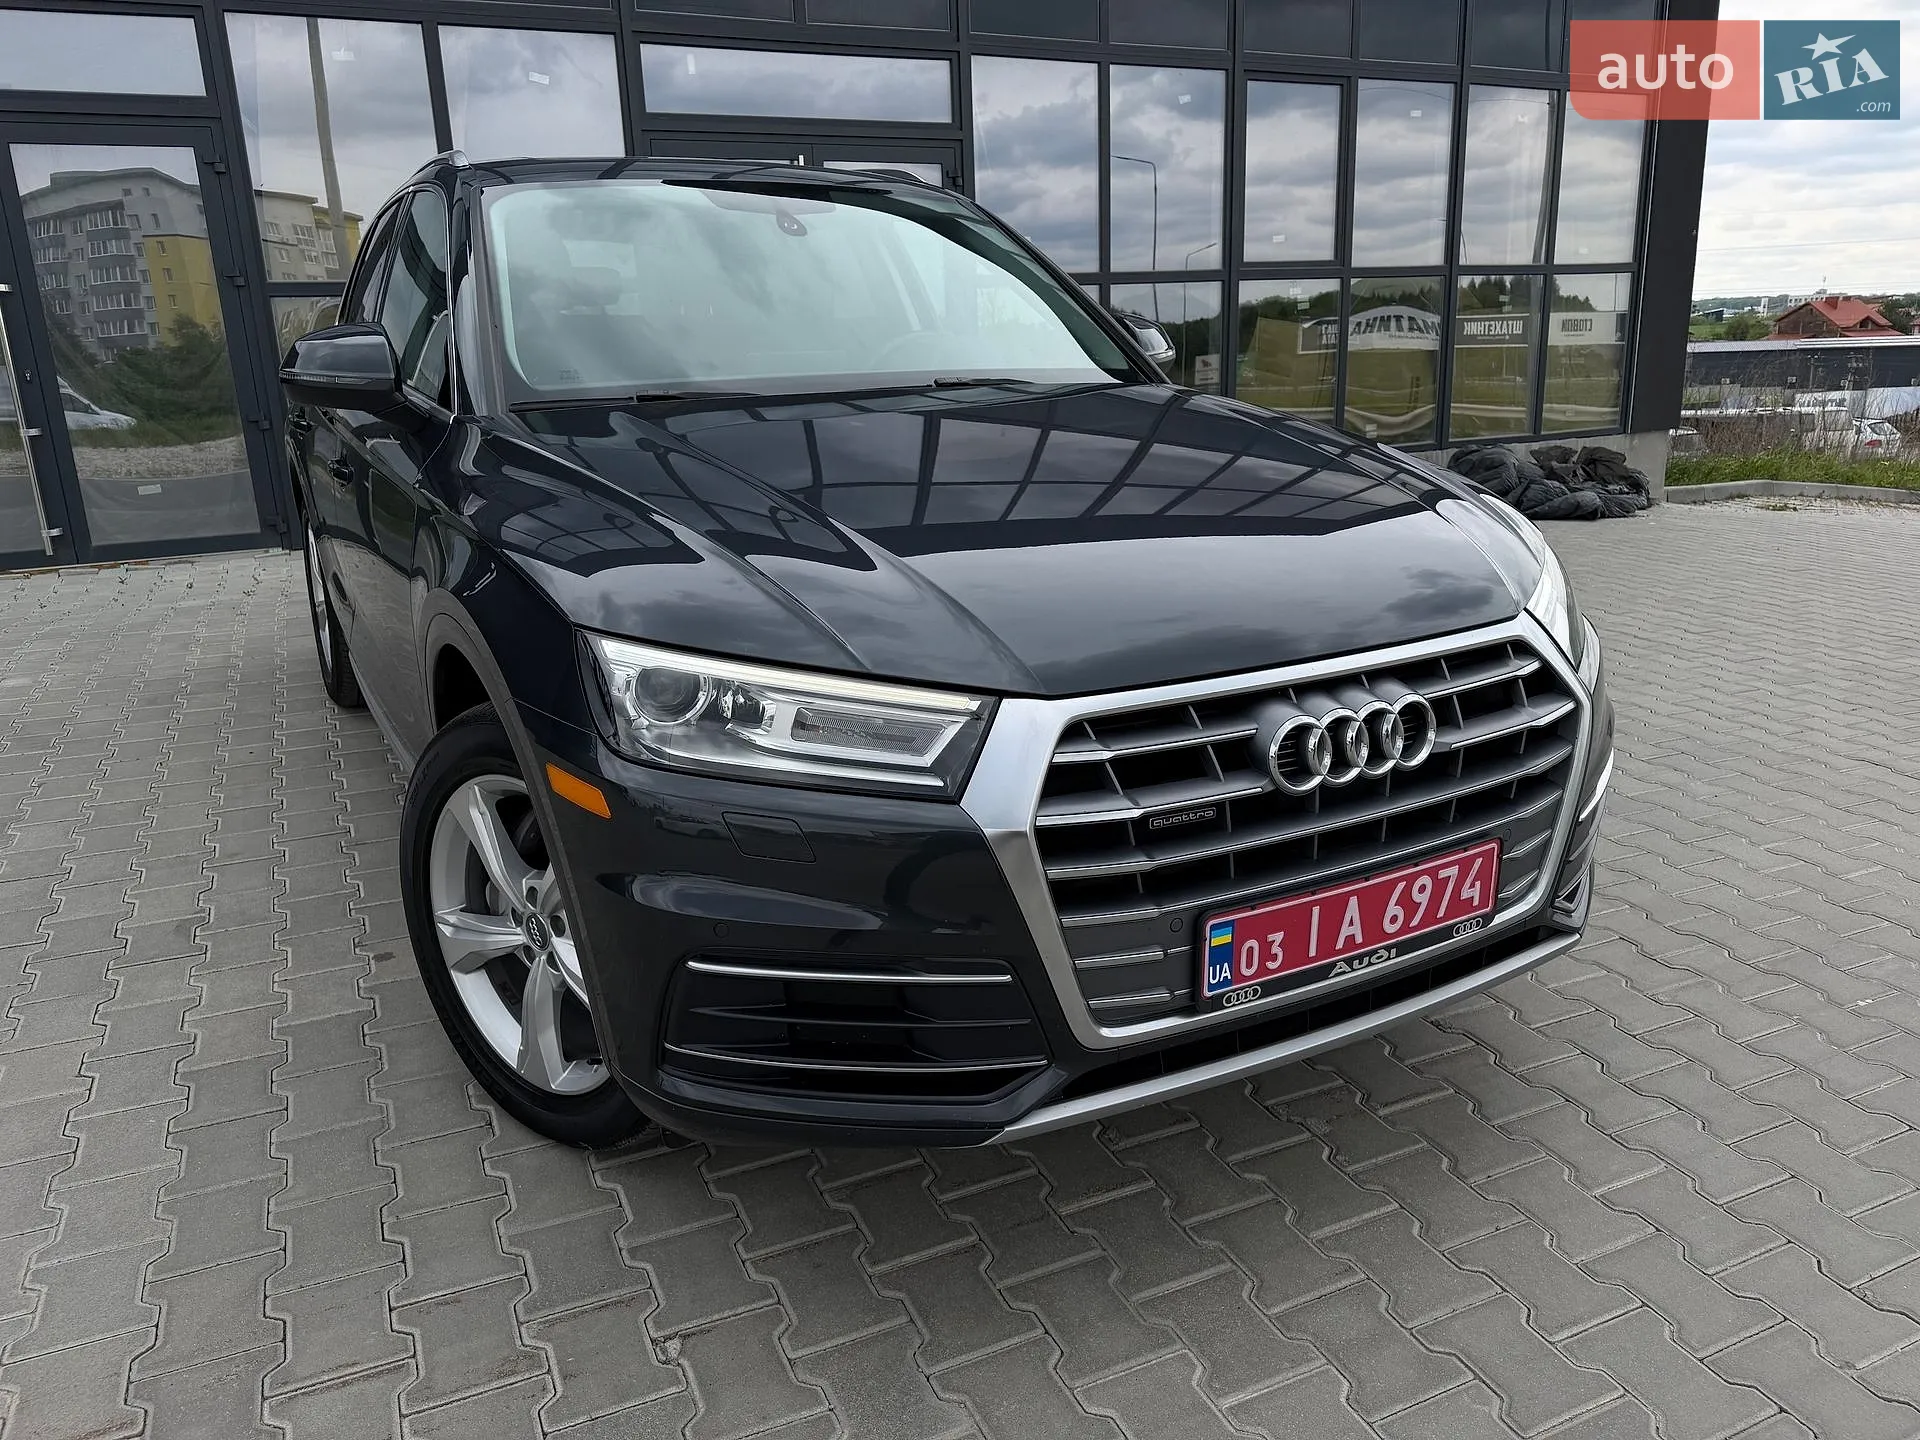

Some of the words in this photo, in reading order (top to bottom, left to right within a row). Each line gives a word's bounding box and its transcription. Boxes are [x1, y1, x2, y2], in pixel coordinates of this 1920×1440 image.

[1153, 810, 1214, 828] quattro
[1209, 962, 1231, 984] UA
[1240, 931, 1285, 977] 03
[1382, 857, 1483, 934] 6974
